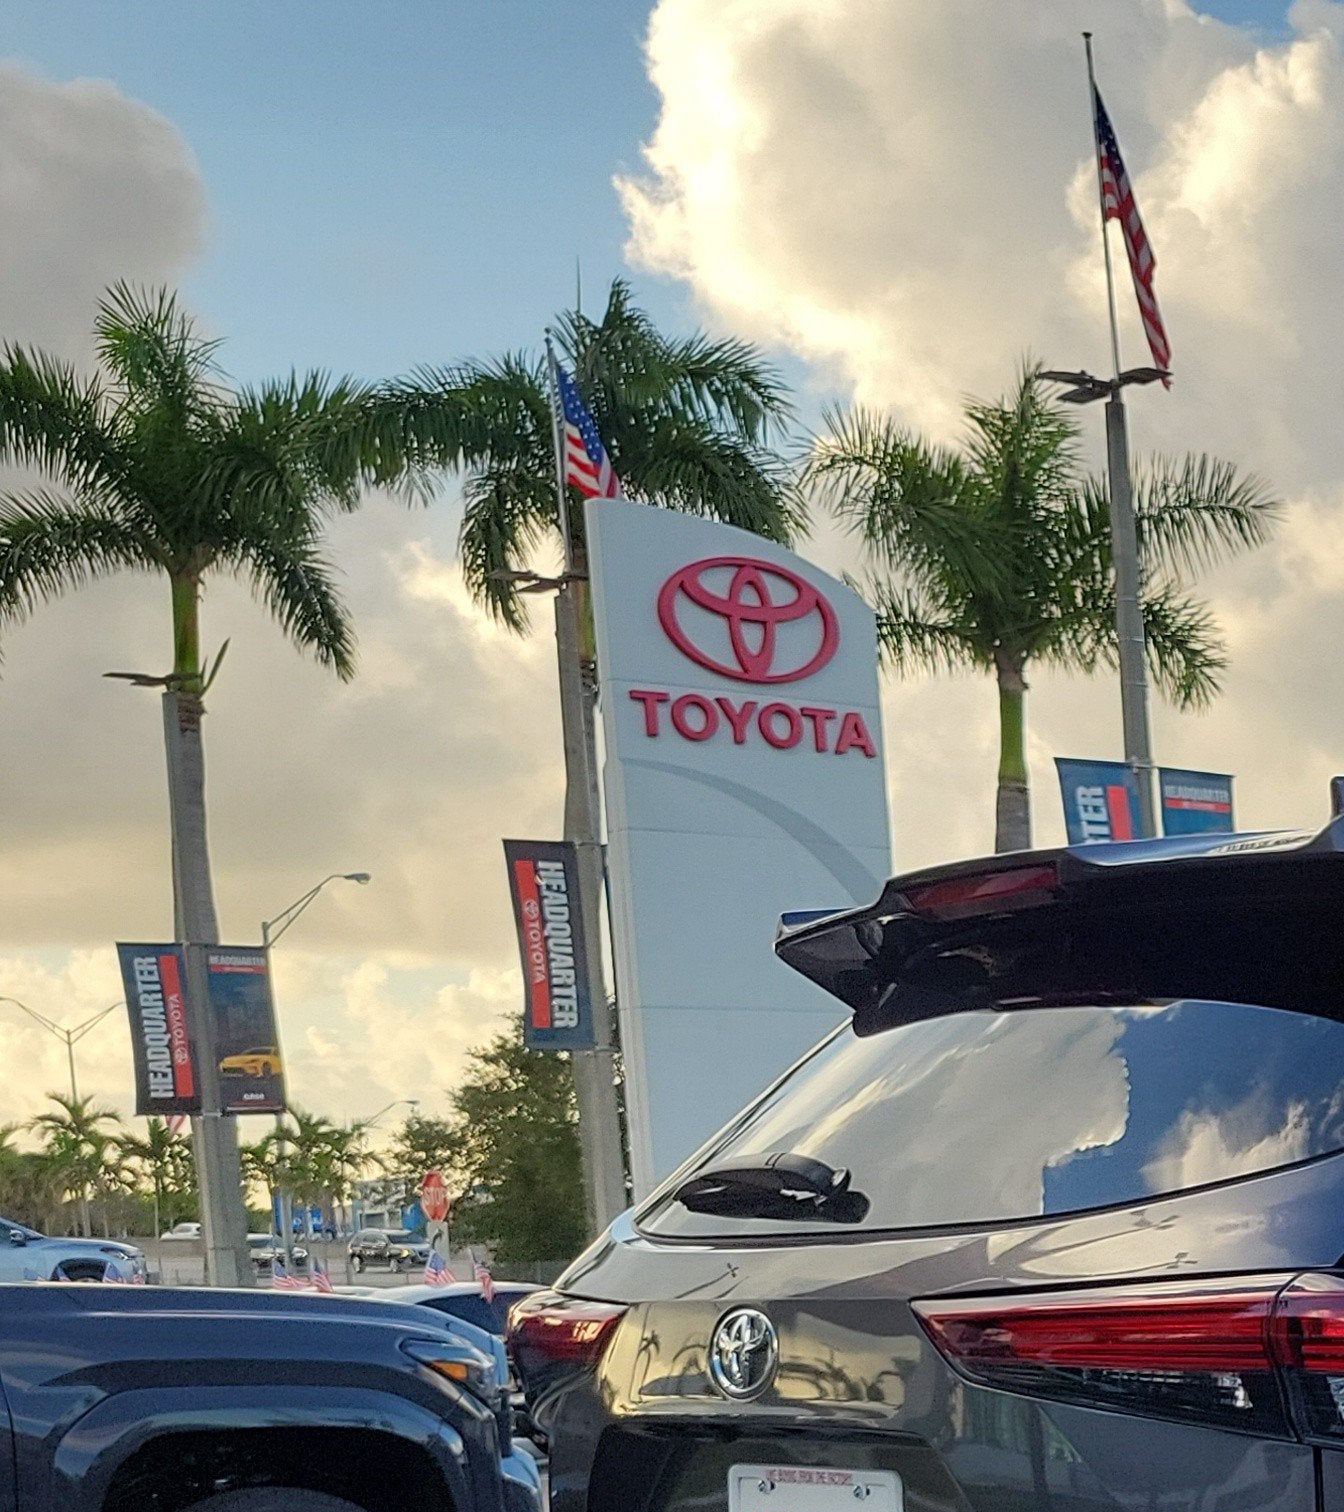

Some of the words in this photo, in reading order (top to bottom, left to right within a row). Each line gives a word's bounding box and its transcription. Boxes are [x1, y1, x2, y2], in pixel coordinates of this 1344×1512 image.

[628, 689, 876, 758] TOYOTA
[528, 920, 546, 984] TOYOTA
[537, 860, 580, 1029] HEADQUARTER
[134, 956, 175, 1098] HEADQUARTER
[169, 995, 189, 1046] TOYOTA
